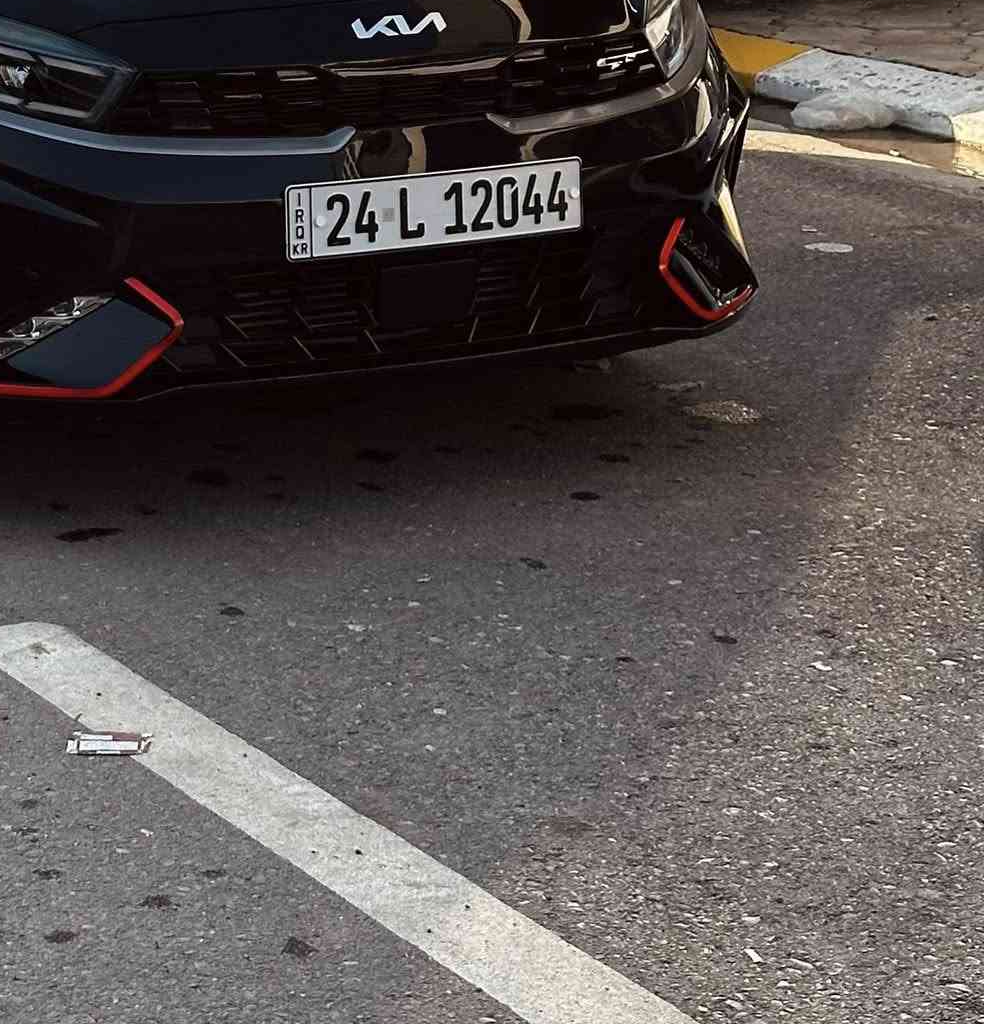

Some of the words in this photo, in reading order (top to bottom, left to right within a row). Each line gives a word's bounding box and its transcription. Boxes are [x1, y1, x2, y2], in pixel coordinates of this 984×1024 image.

[326, 190, 379, 247] 24
[399, 187, 425, 239] L
[444, 171, 568, 235] 12044
[292, 242, 309, 256] KR
